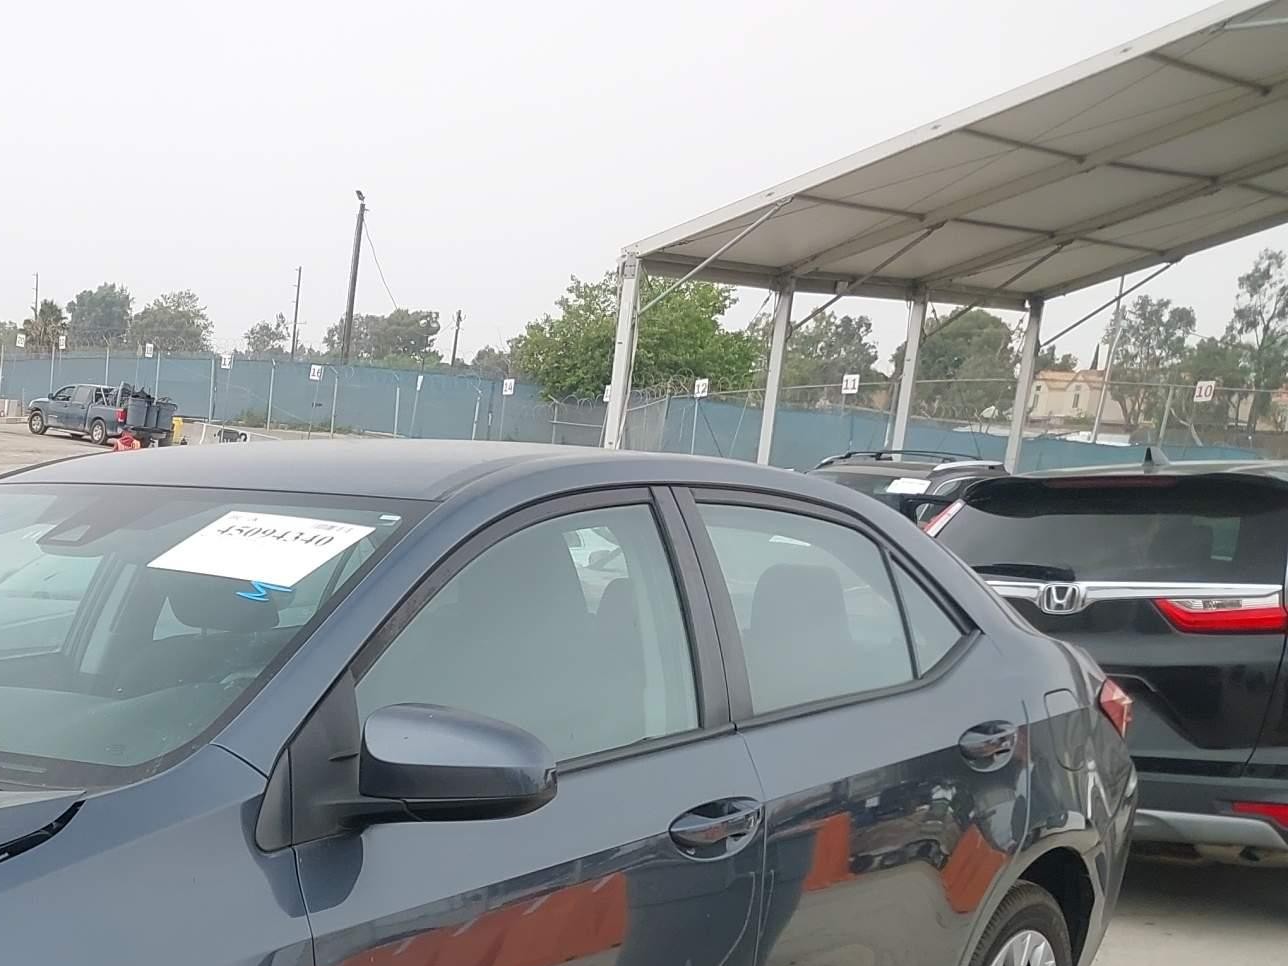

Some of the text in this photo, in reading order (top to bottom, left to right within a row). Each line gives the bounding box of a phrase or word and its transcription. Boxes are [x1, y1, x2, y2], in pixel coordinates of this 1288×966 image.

[311, 366, 322, 377] 16
[503, 380, 514, 393] 14
[695, 383, 708, 395] 12
[844, 377, 858, 391] 11
[1195, 384, 1213, 398] 10
[216, 524, 335, 547] 45094340
